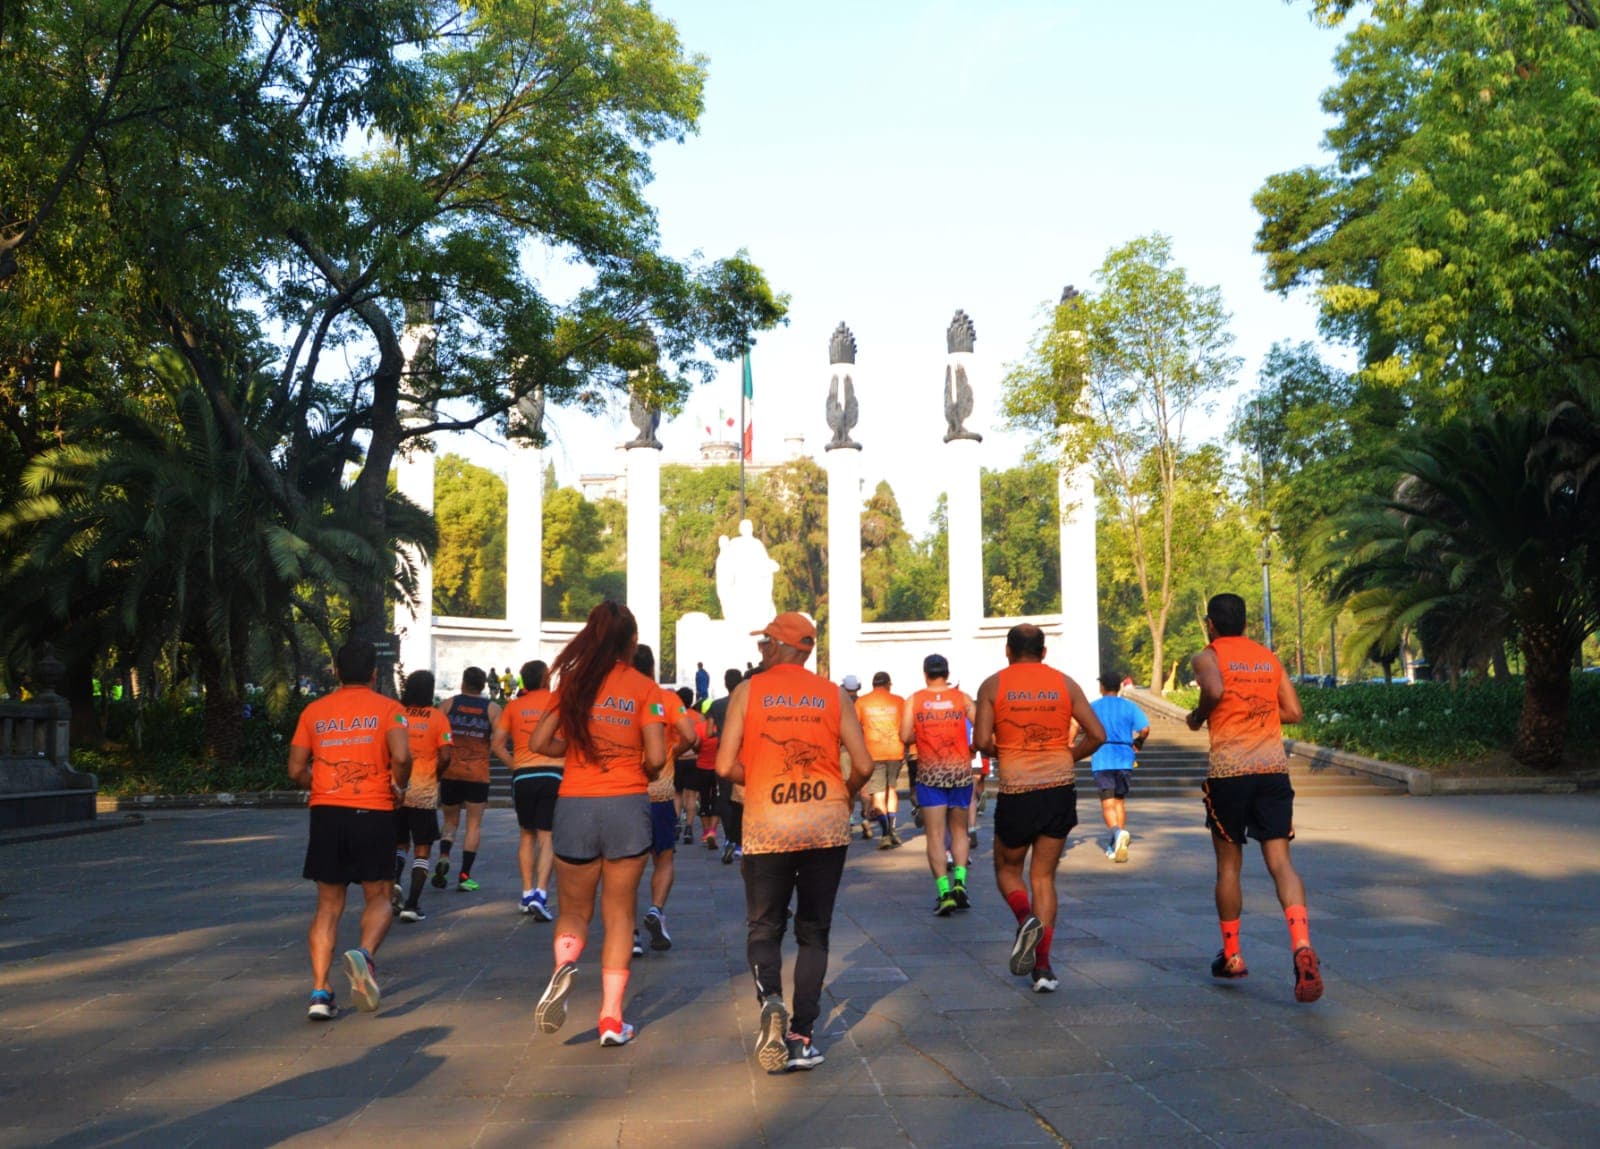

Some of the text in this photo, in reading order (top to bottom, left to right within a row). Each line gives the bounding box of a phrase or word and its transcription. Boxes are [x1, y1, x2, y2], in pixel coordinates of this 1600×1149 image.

[763, 695, 826, 709] BALAM
[1007, 690, 1059, 702] BALAM
[800, 715, 822, 724] CLUB
[916, 711, 963, 722] BALAM
[314, 715, 378, 735] BALAM
[771, 780, 828, 805] GABO
